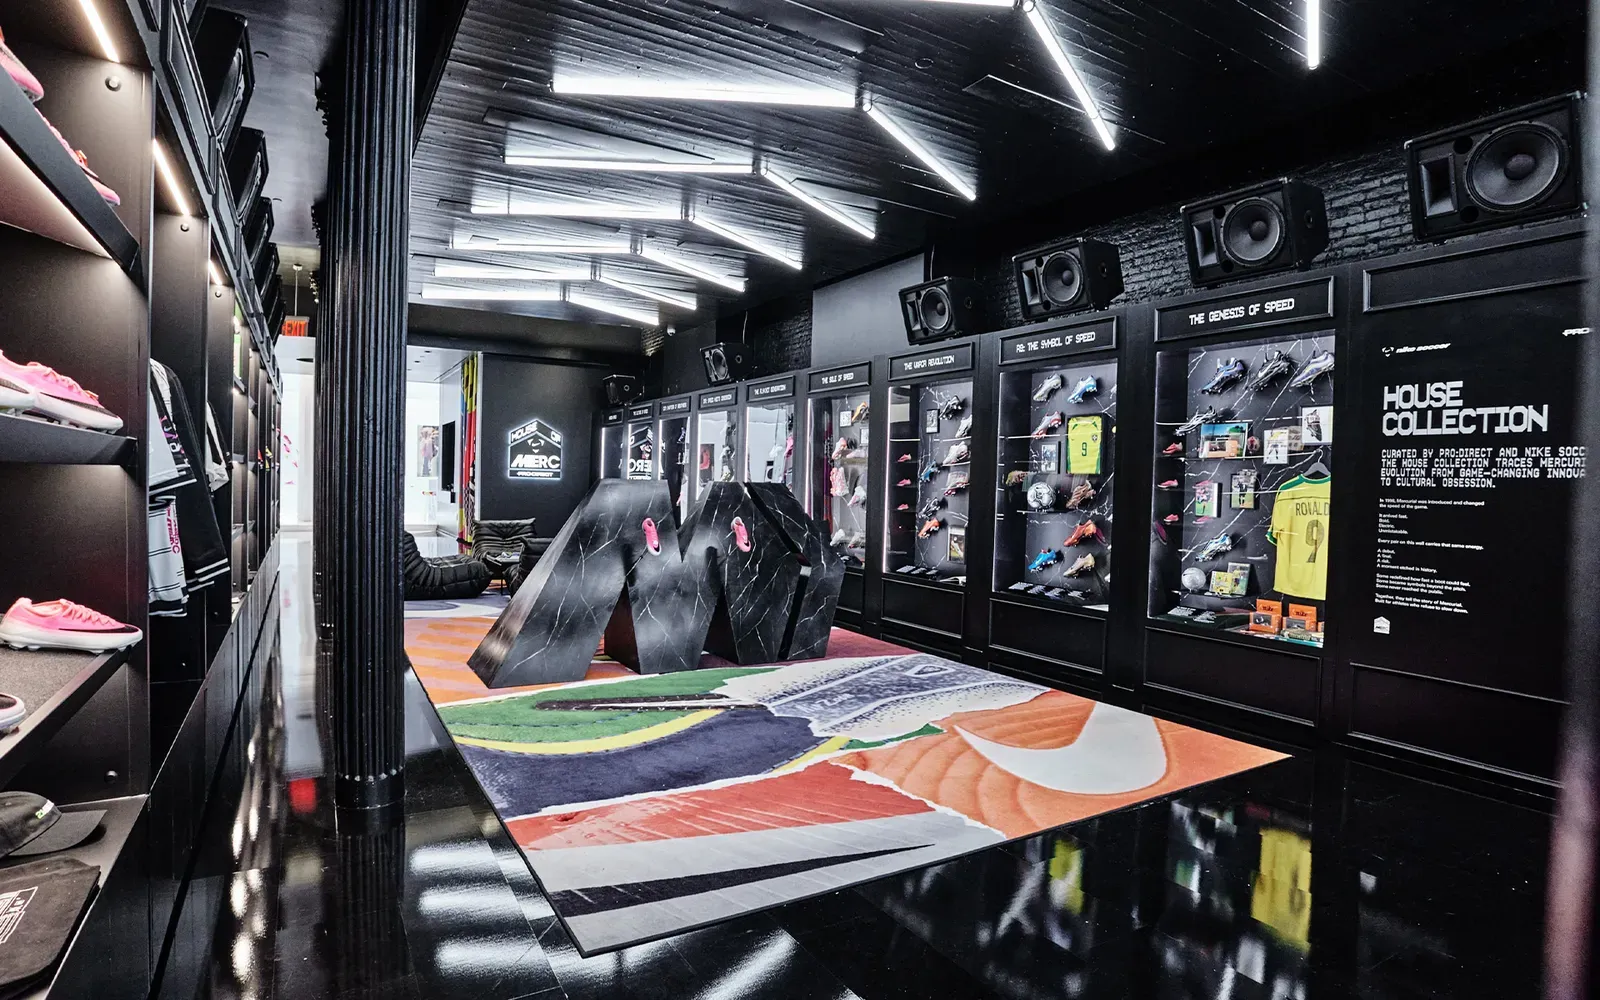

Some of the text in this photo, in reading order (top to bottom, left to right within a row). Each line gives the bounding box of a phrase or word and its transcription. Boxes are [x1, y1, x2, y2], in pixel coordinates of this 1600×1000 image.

[1189, 298, 1294, 325] THE GENESIS OF SPEED
[286, 320, 306, 336] EXIT
[1028, 341, 1038, 351] THE
[1041, 338, 1062, 349] SYMBOL
[1065, 335, 1073, 345] OF
[1076, 332, 1096, 344] SPEED
[904, 362, 913, 371] THE
[1383, 380, 1463, 410] HOUSE
[1382, 404, 1548, 436] COLLECTION
[512, 422, 538, 441] HOUSE
[551, 431, 561, 442] OF
[1082, 442, 1087, 456] 9
[1382, 446, 1587, 458] CURATED BY PRO:DIRECT AND NIKE SOCC
[511, 454, 560, 468] MERC
[1382, 459, 1396, 468] THE
[1402, 458, 1428, 468] HOUSE
[1434, 458, 1489, 468] COLLECTION
[1496, 458, 1533, 467] TRACES
[1381, 468, 1426, 477] EVOLUTION
[1431, 468, 1454, 477] FROM
[1460, 468, 1540, 478] GAME-CHANGING
[1380, 477, 1496, 488] TO CULTURAL OBSESSION.
[1305, 520, 1324, 563] 9
